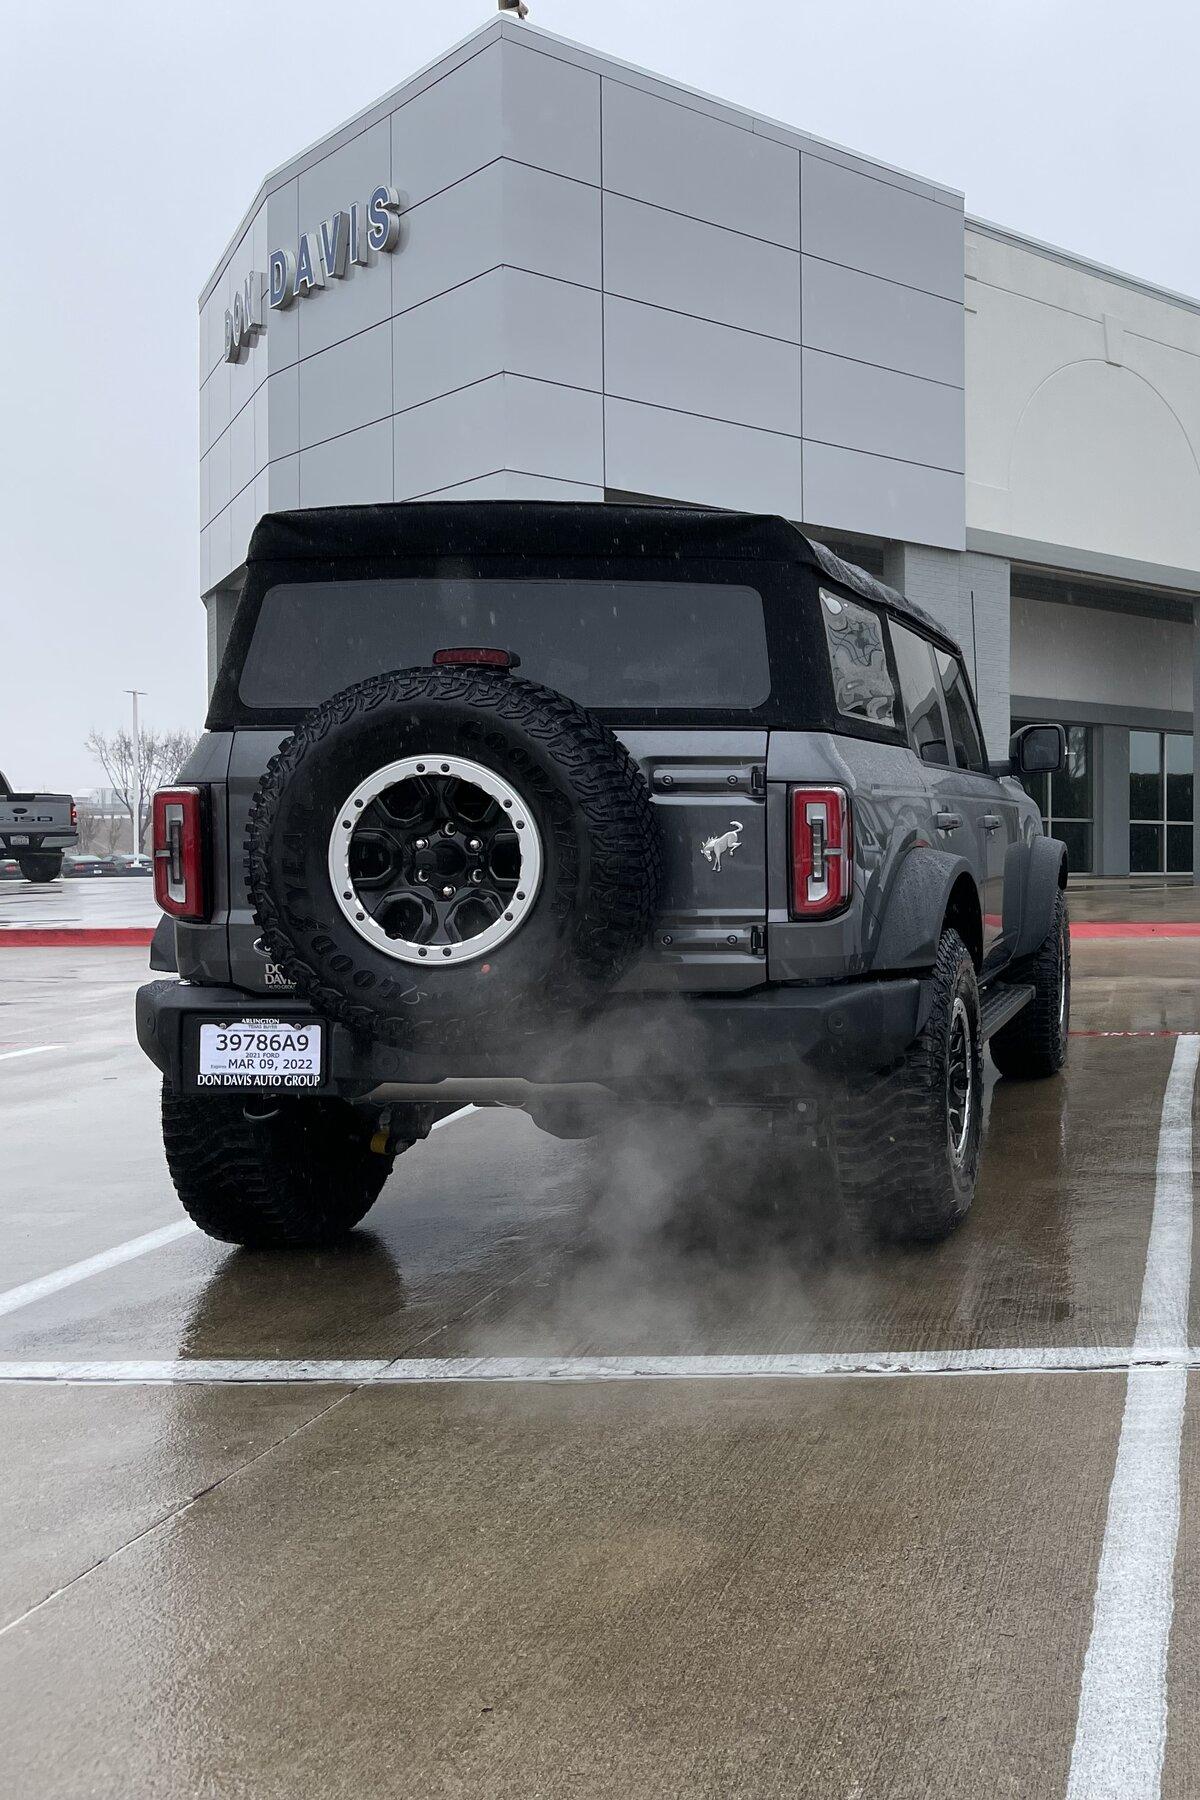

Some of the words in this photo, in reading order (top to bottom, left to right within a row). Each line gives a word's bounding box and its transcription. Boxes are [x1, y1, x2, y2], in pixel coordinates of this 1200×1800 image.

[269, 184, 400, 310] DAVIS
[216, 1034, 309, 1052] 39786A9
[228, 1059, 255, 1069] MAR
[259, 1059, 278, 1071] 09,
[283, 1059, 313, 1069] 2022
[197, 1074, 221, 1086] DON
[223, 1074, 252, 1086] DAVIS
[253, 1074, 282, 1086] AUTO
[284, 1074, 321, 1087] GROUP
